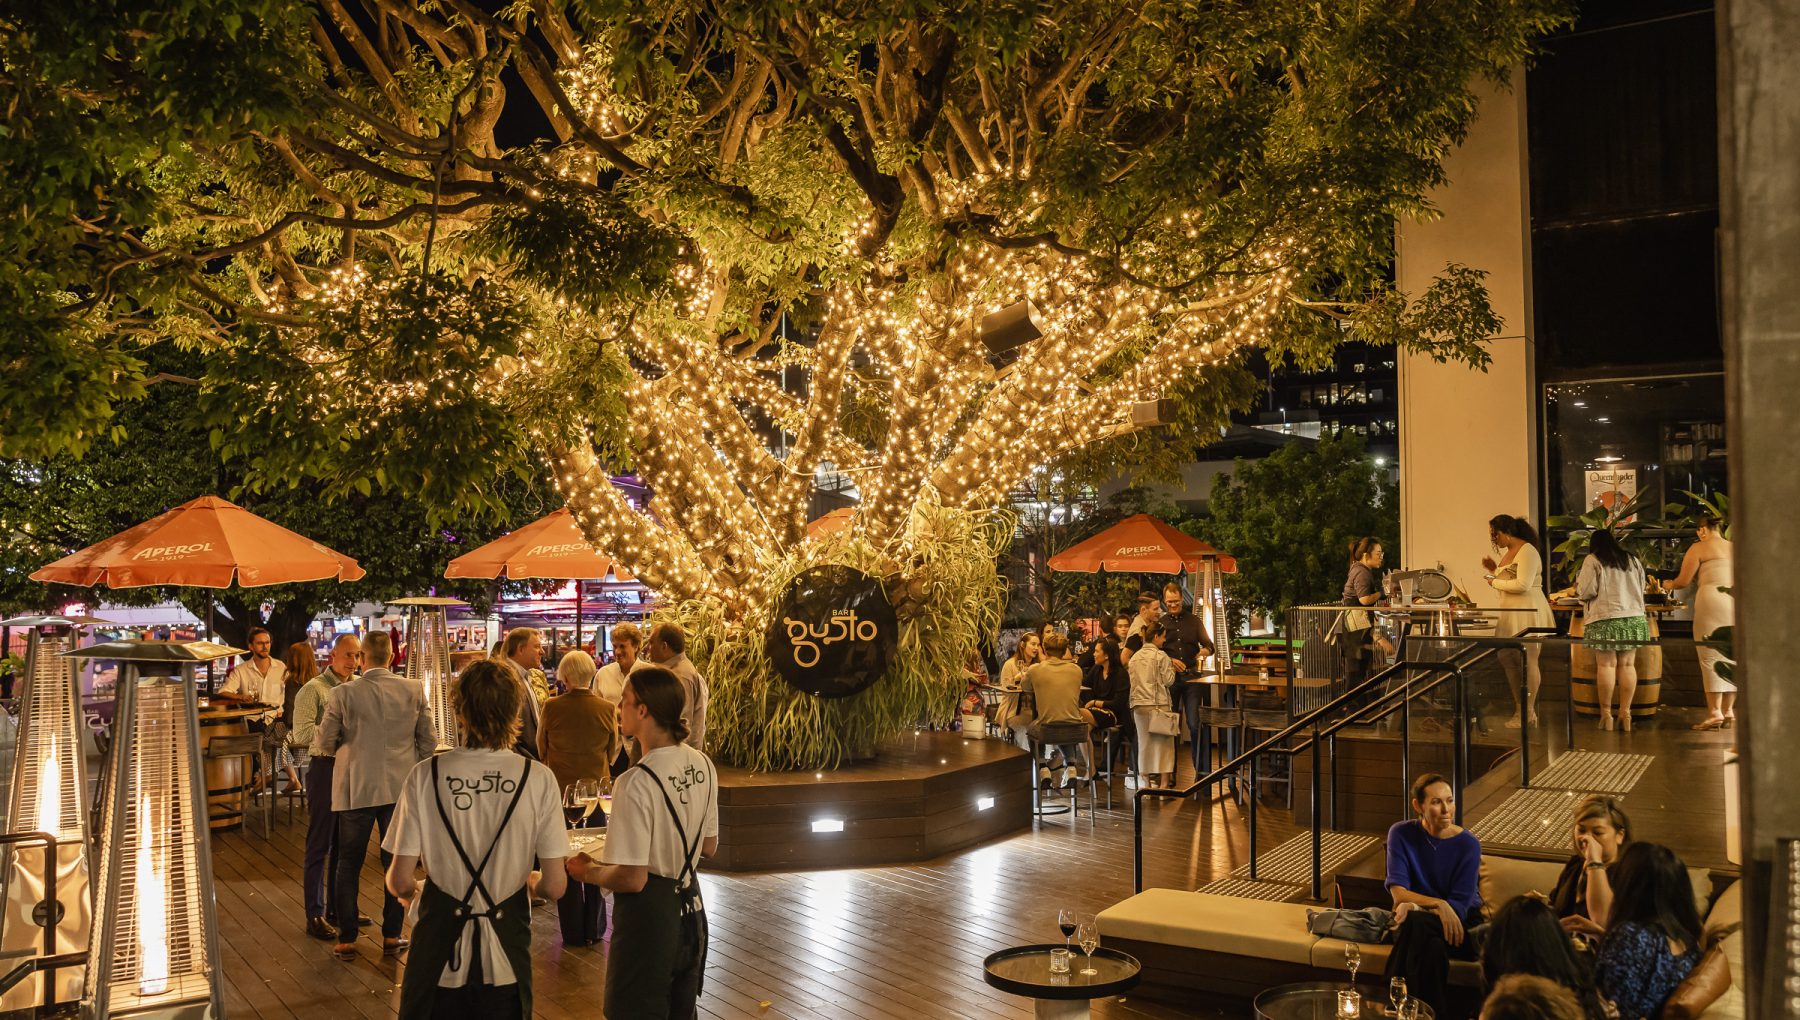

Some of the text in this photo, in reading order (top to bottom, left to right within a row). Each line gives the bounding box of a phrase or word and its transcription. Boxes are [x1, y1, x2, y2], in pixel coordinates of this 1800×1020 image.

[132, 543, 214, 561] APEROL
[527, 543, 592, 557] APEROL
[1115, 544, 1164, 556] APEROL
[783, 609, 878, 668] gusto
[446, 771, 516, 811] gusto
